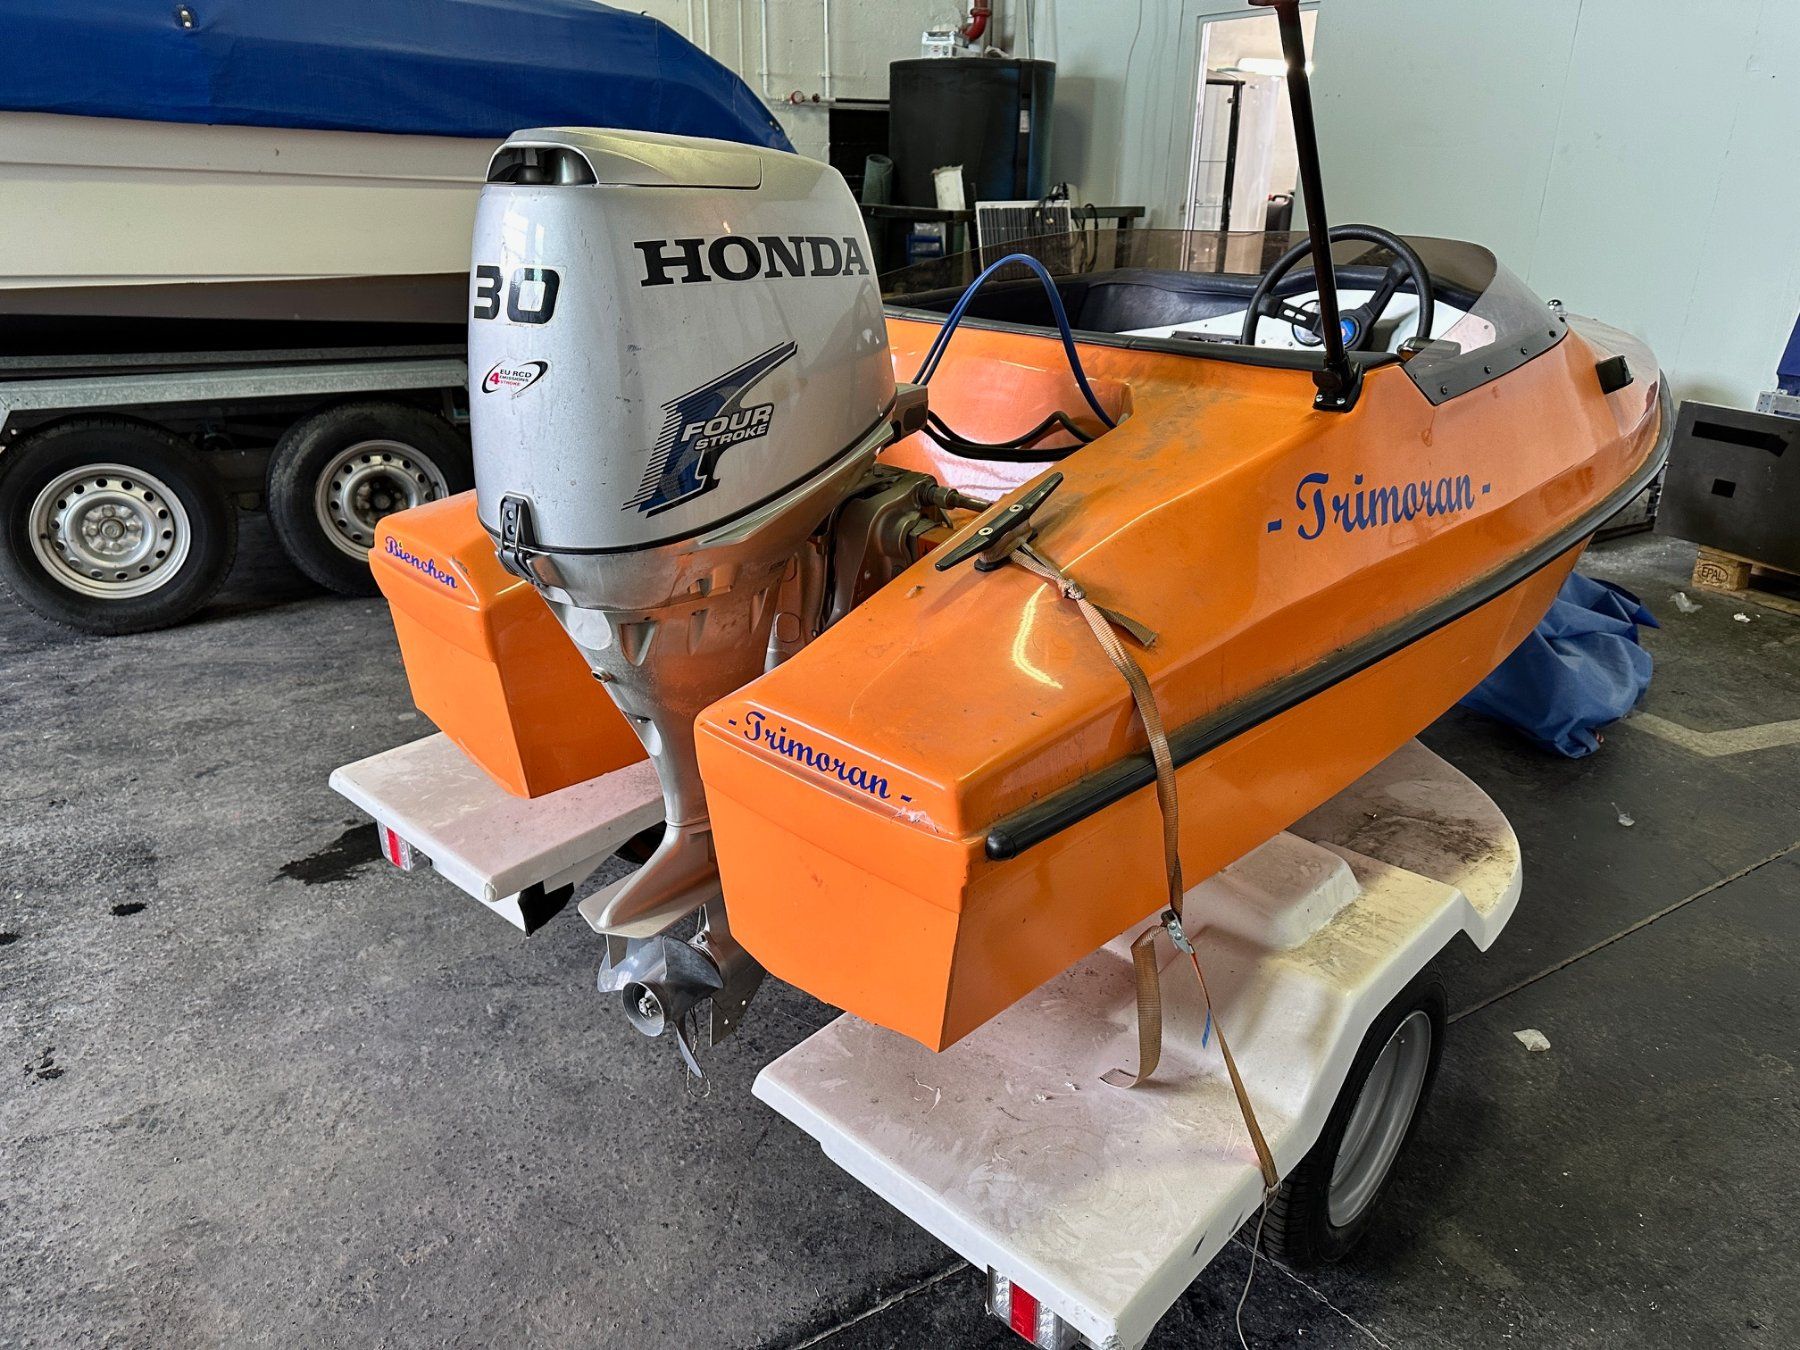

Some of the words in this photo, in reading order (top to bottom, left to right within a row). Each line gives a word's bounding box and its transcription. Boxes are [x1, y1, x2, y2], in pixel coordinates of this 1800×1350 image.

[634, 236, 869, 286] HONDA
[474, 265, 560, 324] 30
[489, 372, 500, 385] 4
[681, 405, 773, 441] FOUR
[695, 423, 767, 450] STROKE
[1296, 472, 1475, 540] Trimoran
[385, 536, 458, 588] Bienchen
[1702, 566, 1722, 582] EPAL
[744, 711, 891, 799] Trimoran
